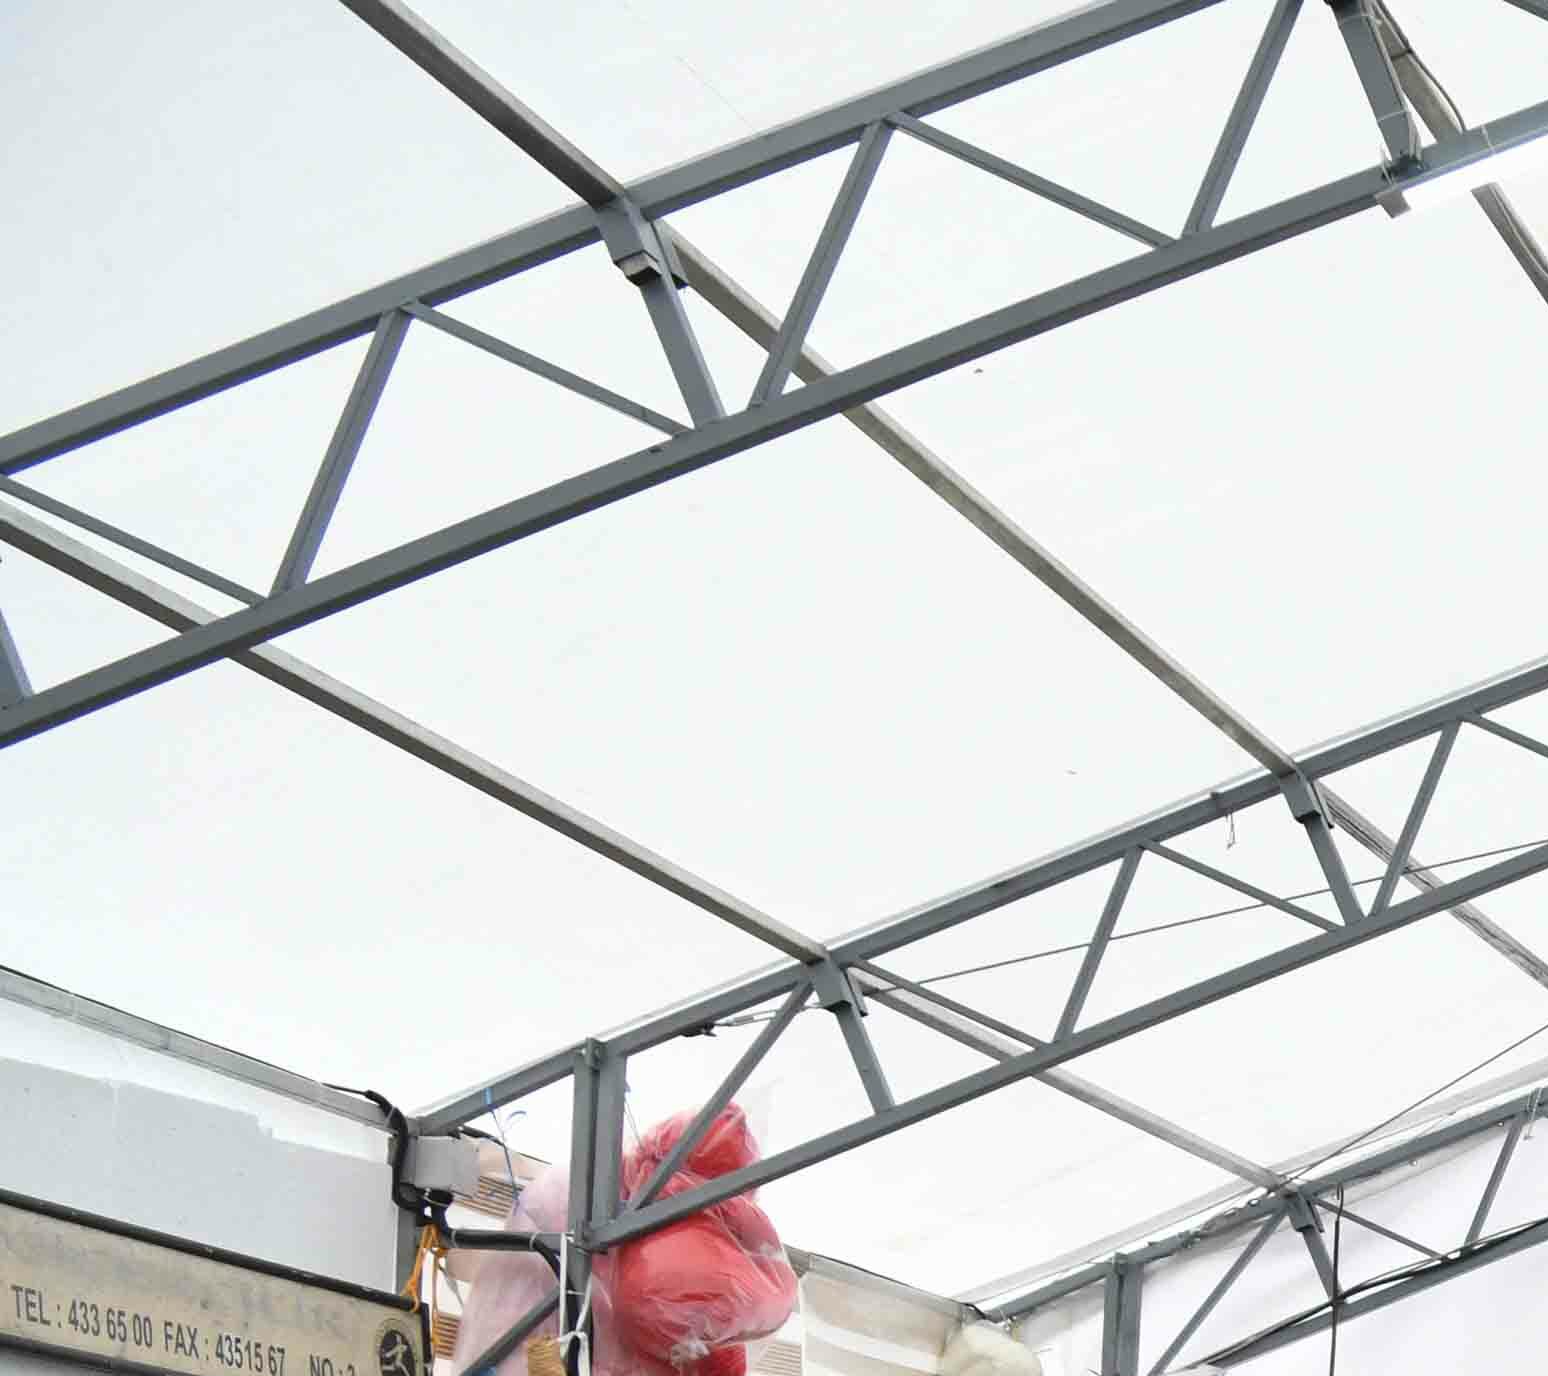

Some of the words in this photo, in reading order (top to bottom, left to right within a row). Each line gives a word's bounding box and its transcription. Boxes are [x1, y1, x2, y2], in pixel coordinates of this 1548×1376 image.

[11, 1284, 50, 1327] TEL
[68, 1299, 100, 1337] 433
[106, 1307, 127, 1343] 65
[132, 1313, 153, 1348] 00
[164, 1320, 200, 1359] FAX
